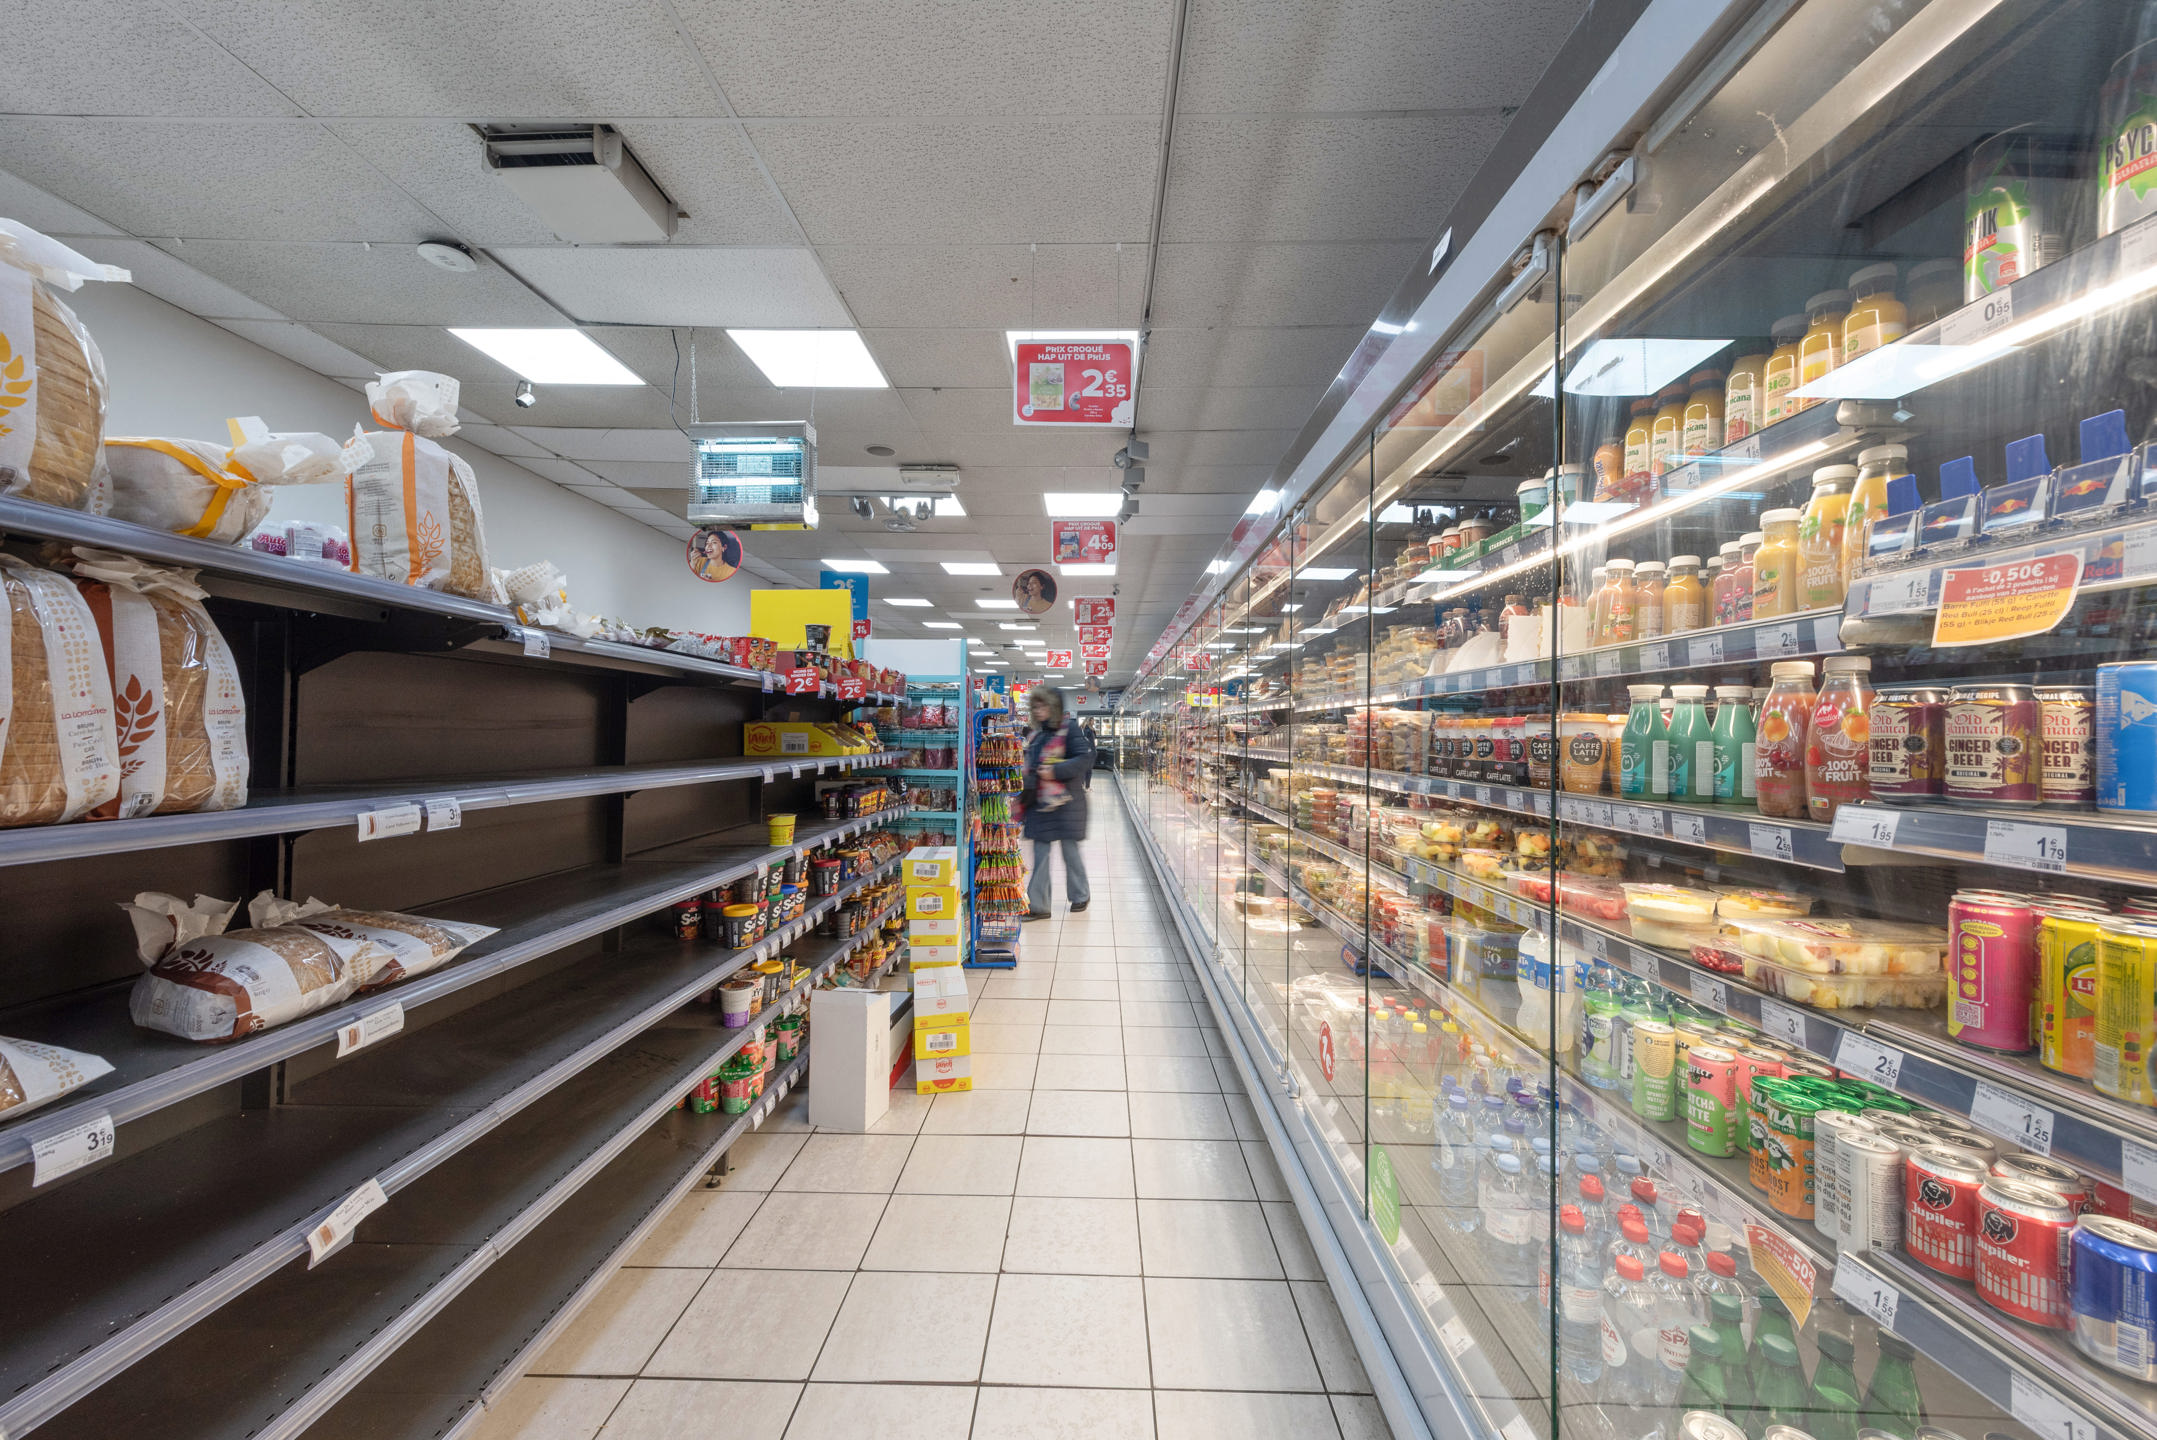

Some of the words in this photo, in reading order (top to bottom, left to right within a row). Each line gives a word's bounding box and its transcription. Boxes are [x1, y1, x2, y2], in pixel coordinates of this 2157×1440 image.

[1045, 345, 1066, 353] PRIX
[1037, 353, 1056, 361] HAP
[1058, 353, 1072, 361] UIT
[1074, 353, 1086, 361] DE
[2083, 559, 2117, 579] Red
[1806, 573, 1838, 588] FRUIT
[1906, 579, 1927, 598] 1€55
[1781, 632, 1798, 648] 2€59
[794, 677, 814, 692] 2€
[844, 686, 861, 698] 2€
[1954, 713, 1982, 726] Old
[1946, 722, 1999, 736] Jamaica
[1573, 741, 1600, 750] CAFFÈ
[1574, 749, 1600, 757] LATTE
[1949, 739, 1991, 753] GINGER
[2042, 739, 2080, 755] NGER
[1826, 759, 1859, 771] 100%
[1953, 753, 1983, 766] BEER
[2044, 755, 2072, 767] EER
[1825, 770, 1862, 782] FRUIT
[1871, 822, 1892, 842] 1€95
[1775, 835, 1791, 853] 2€59
[2036, 837, 2065, 860] 1€79
[1875, 1055, 1898, 1079] 2€35
[2023, 1113, 2049, 1143] 1€25
[87, 1128, 113, 1152] 3€19
[1911, 1201, 1966, 1231] Jupiler
[1977, 1234, 2031, 1269] Jupiler
[1873, 1290, 1894, 1317] 1€55
